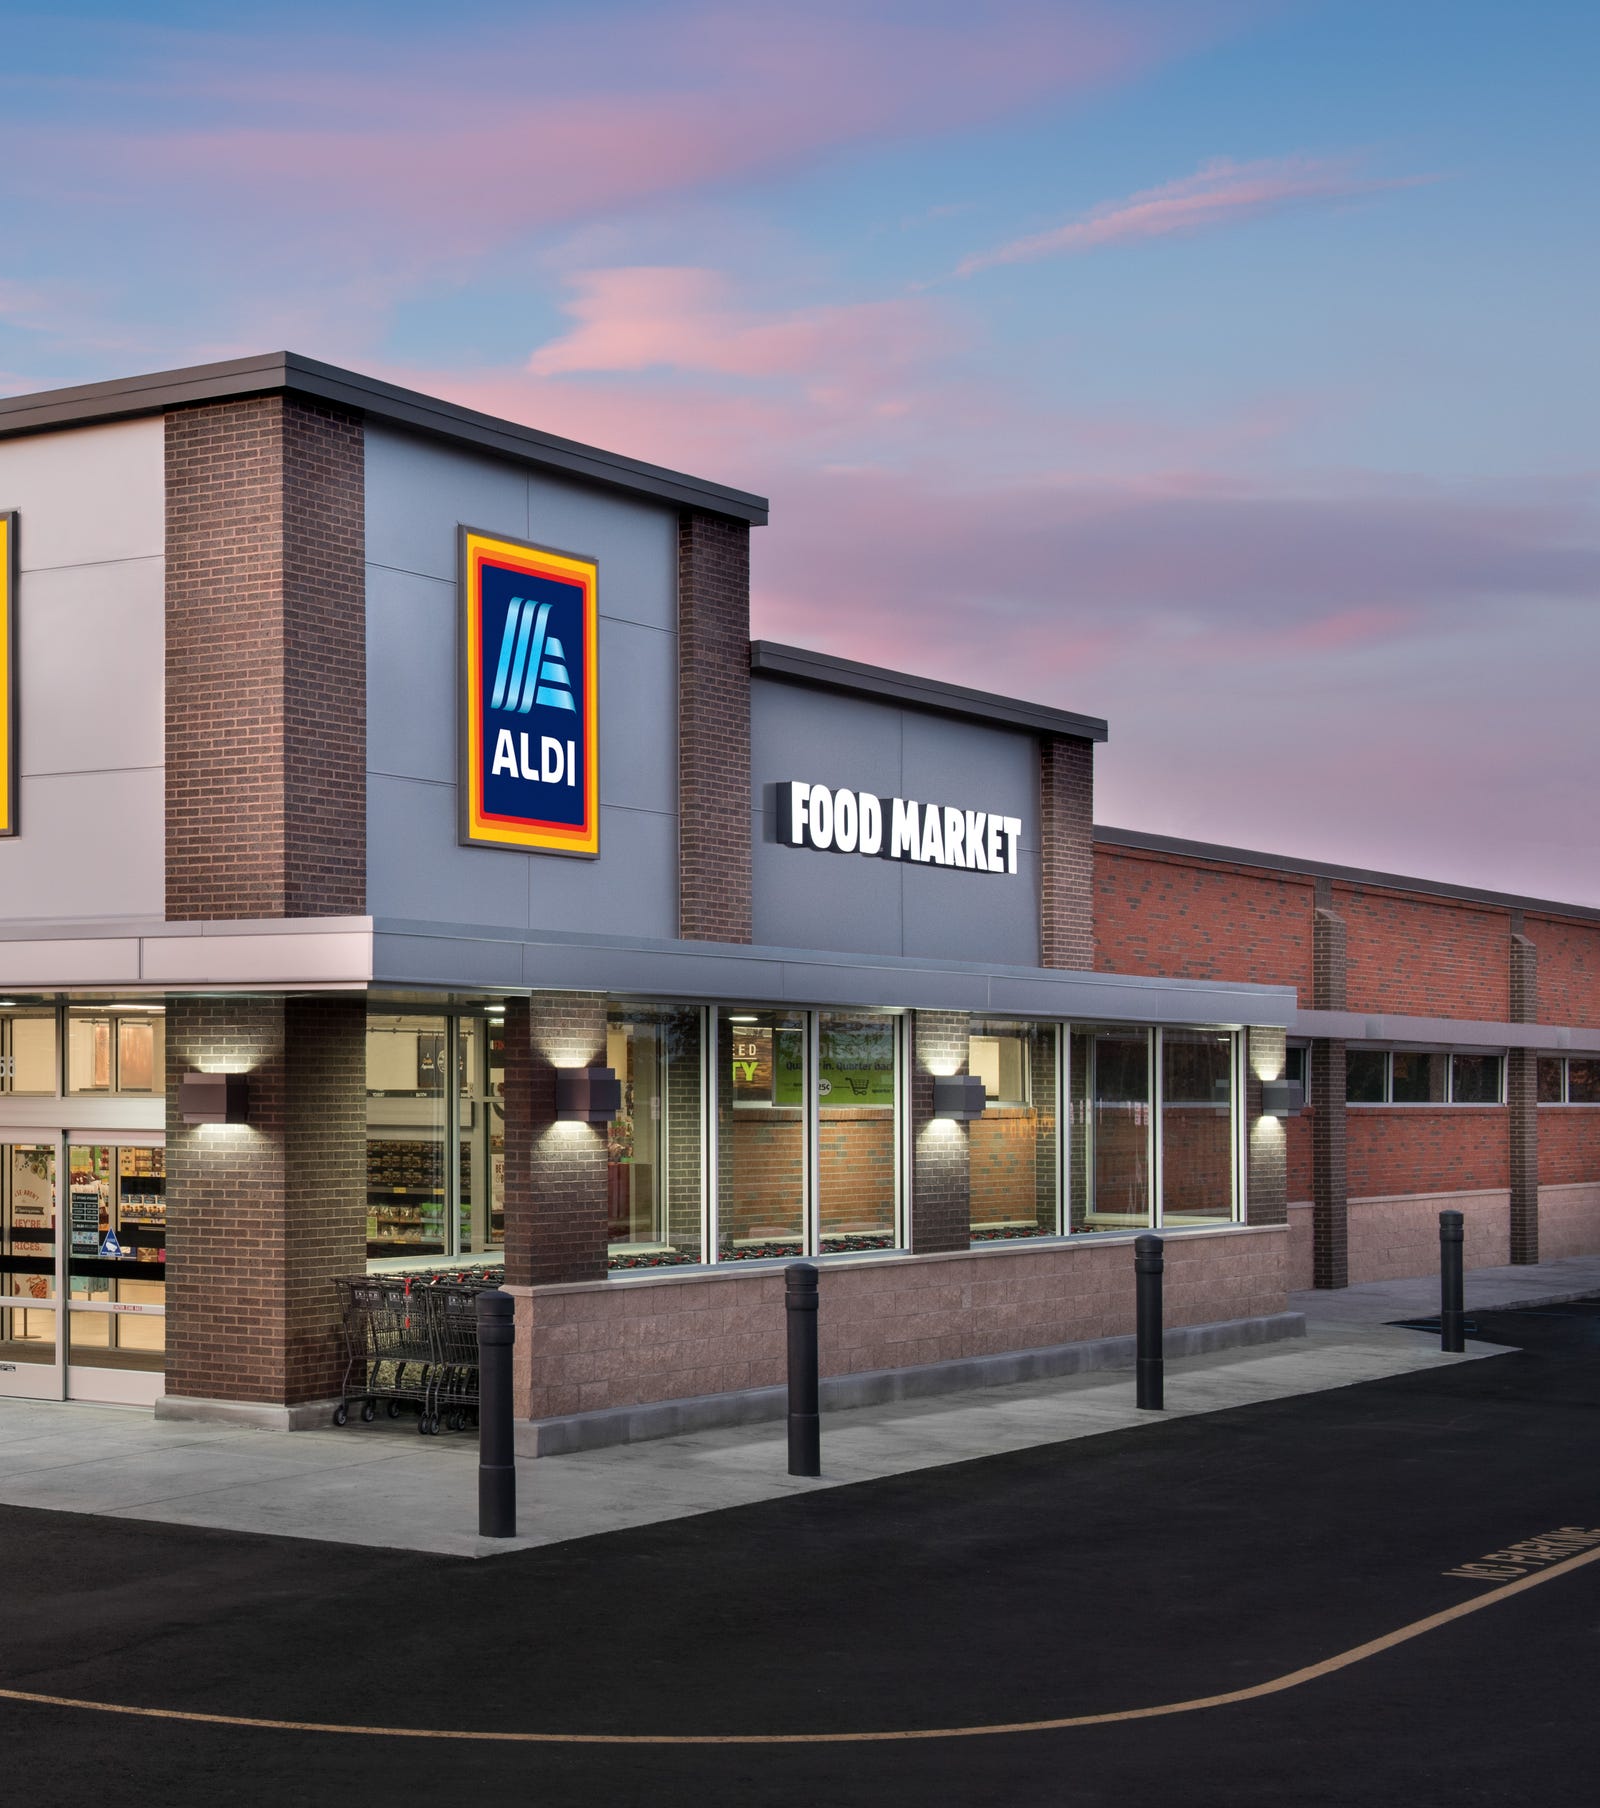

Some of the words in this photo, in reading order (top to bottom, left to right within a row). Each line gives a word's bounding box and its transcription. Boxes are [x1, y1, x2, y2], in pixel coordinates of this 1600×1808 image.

[491, 728, 576, 787] ALDI
[790, 781, 883, 855] FOOD
[890, 797, 1022, 875] MARKET
[15, 1242, 43, 1252] RICES.
[1441, 1563, 1528, 1582] NO
